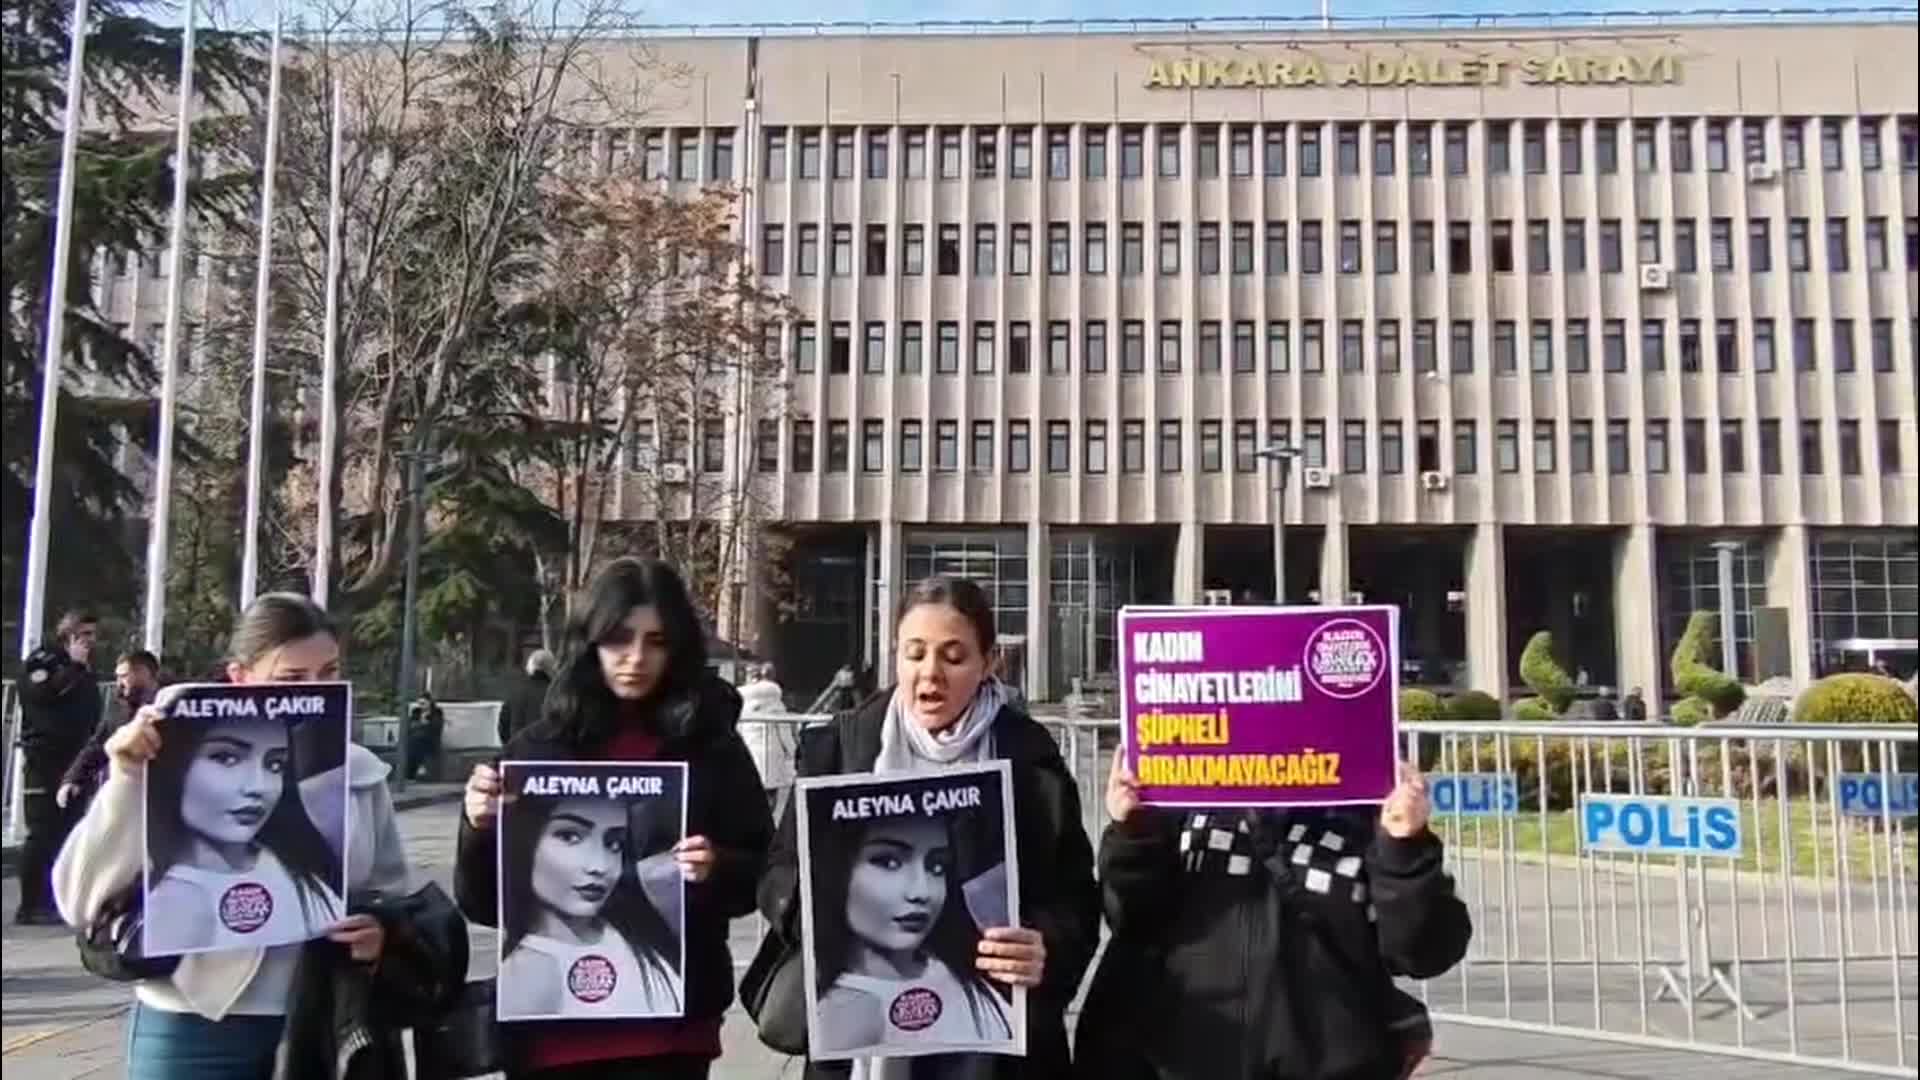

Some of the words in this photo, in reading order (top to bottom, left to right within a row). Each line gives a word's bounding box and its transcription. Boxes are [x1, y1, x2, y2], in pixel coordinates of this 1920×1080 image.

[1145, 58, 1326, 89] ANKARA
[1338, 56, 1508, 87] ADALET
[1521, 53, 1682, 85] SARAYI
[1133, 631, 1204, 664] KADIN
[175, 699, 258, 718] ALEYNA
[265, 695, 325, 720] ÇAKIR
[1136, 708, 1230, 750] ŞÜPHELİ
[1138, 748, 1341, 786] BIRAKMAYACAĞIZ
[523, 776, 600, 795] ALEYNA
[606, 776, 663, 798] ÇAKIR
[832, 794, 916, 821] ALEYNA
[922, 786, 981, 816] ÇAKIR
